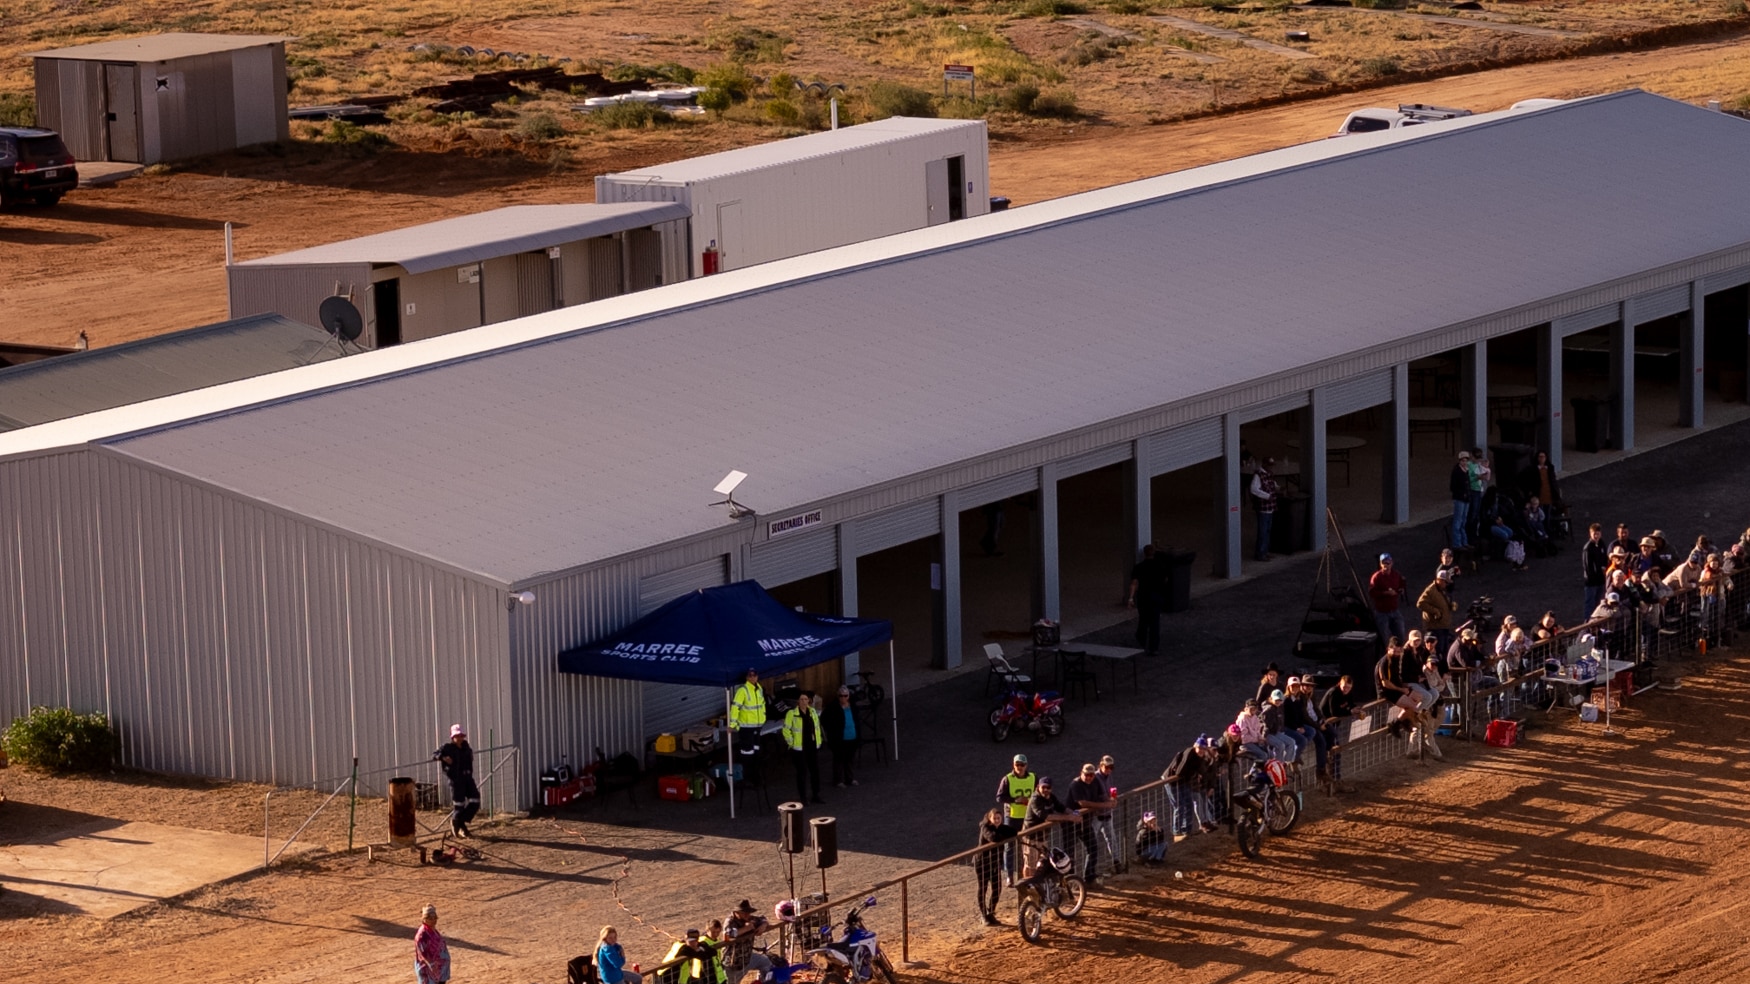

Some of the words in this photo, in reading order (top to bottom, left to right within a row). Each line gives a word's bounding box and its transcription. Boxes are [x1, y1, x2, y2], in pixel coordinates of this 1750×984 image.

[771, 516, 804, 534] SECRETARIES
[804, 511, 821, 525] OFFICE
[614, 642, 704, 655] MARREE
[757, 635, 820, 652] MARREE
[600, 649, 658, 661] SPORTS
[660, 655, 701, 664] CLUB
